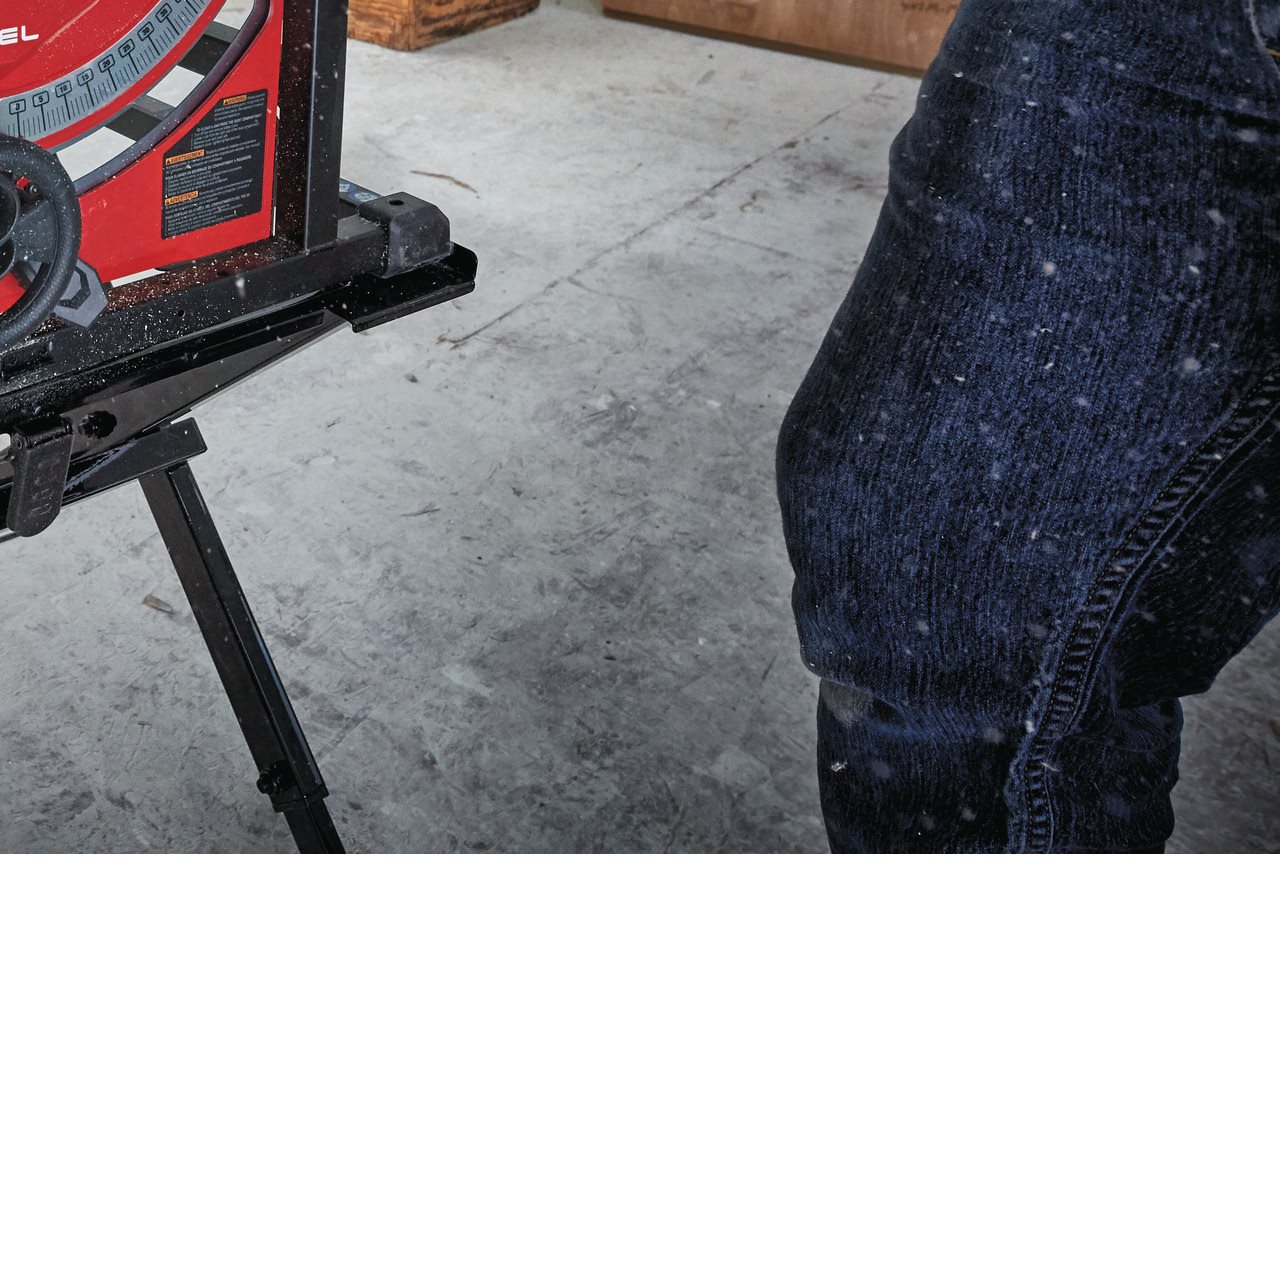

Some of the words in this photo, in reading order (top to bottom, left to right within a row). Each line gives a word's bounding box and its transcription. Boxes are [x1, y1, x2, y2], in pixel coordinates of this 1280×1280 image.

[141, 26, 150, 36] 30
[122, 43, 131, 53] 25
[102, 59, 111, 69] 20
[81, 73, 90, 82] 15
[59, 84, 68, 93] 10
[38, 95, 44, 103] 5
[15, 102, 21, 111] 0
